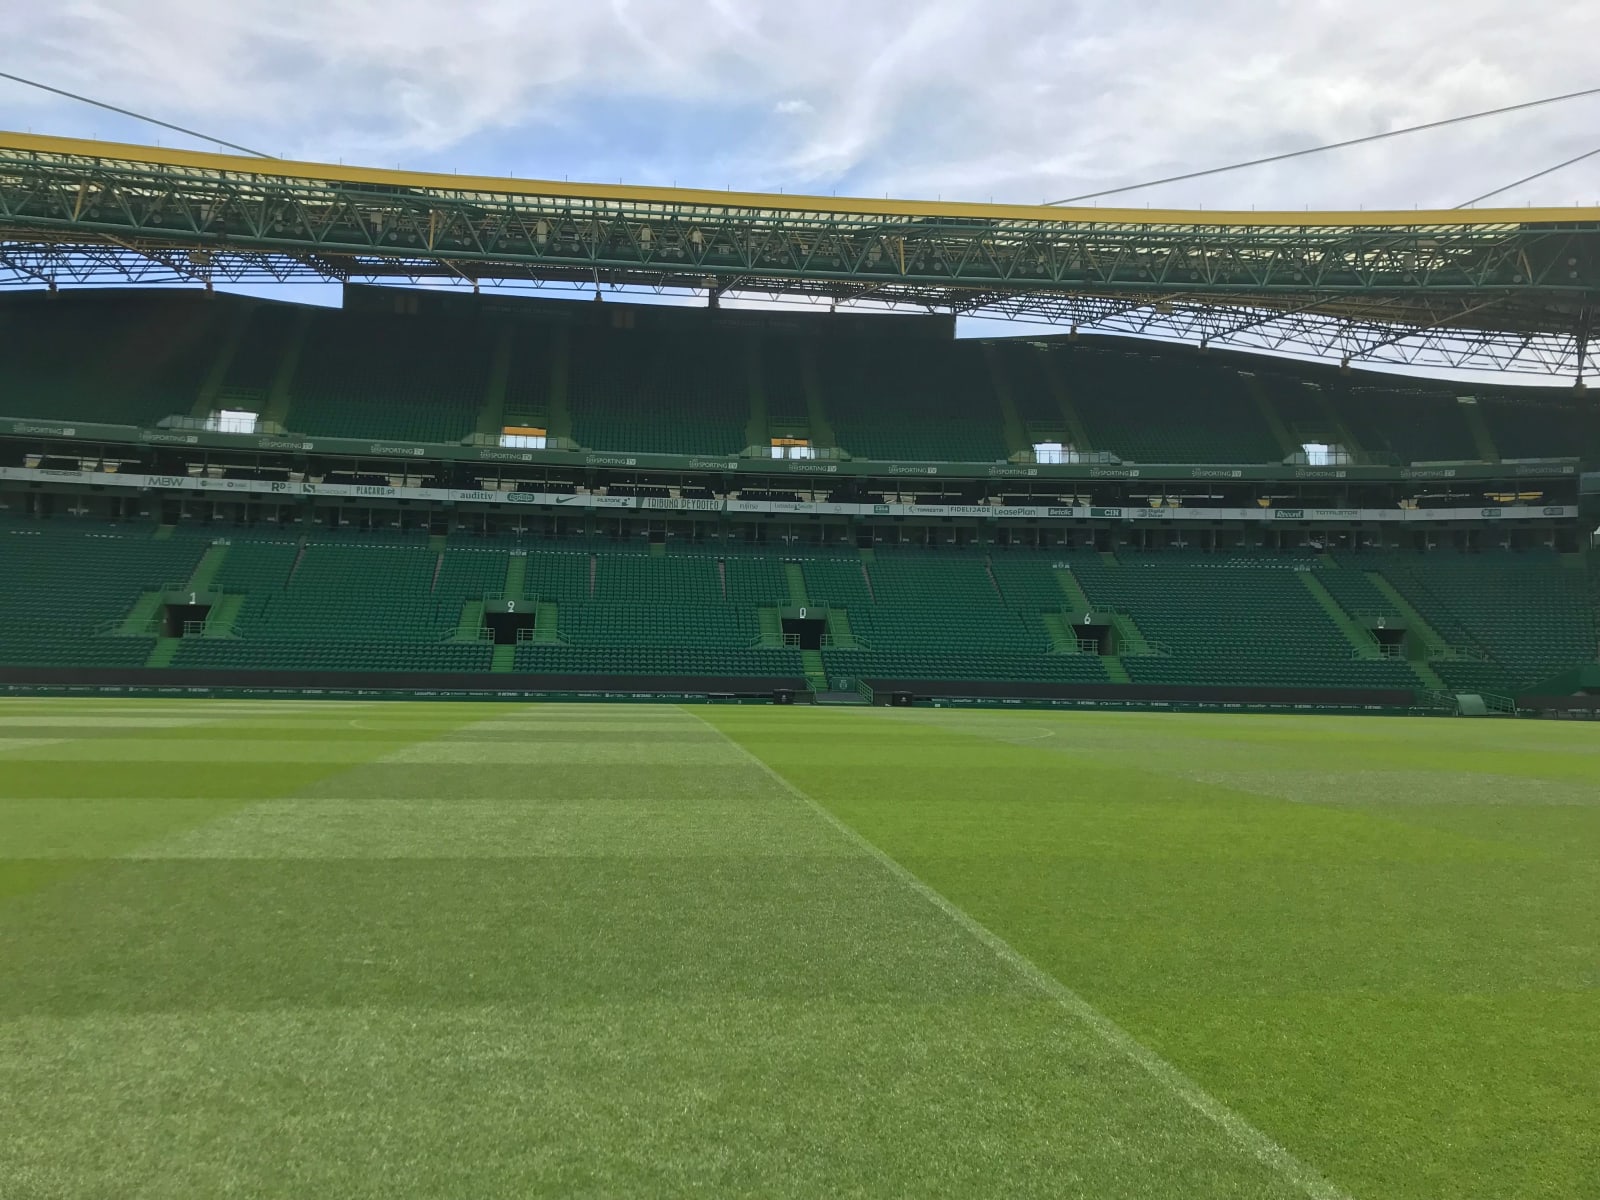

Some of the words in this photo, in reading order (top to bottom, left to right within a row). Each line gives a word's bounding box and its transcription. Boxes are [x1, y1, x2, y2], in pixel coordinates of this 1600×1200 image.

[152, 434, 186, 442] SPORTING
[382, 447, 414, 455] SPORTING
[148, 478, 184, 486] MBW
[460, 492, 493, 500] auditiv
[648, 498, 678, 509] TRIBUNA
[994, 508, 1036, 516] LeasePlan
[188, 592, 196, 604] 1
[507, 601, 514, 612] 9
[1084, 612, 1091, 624] 6
